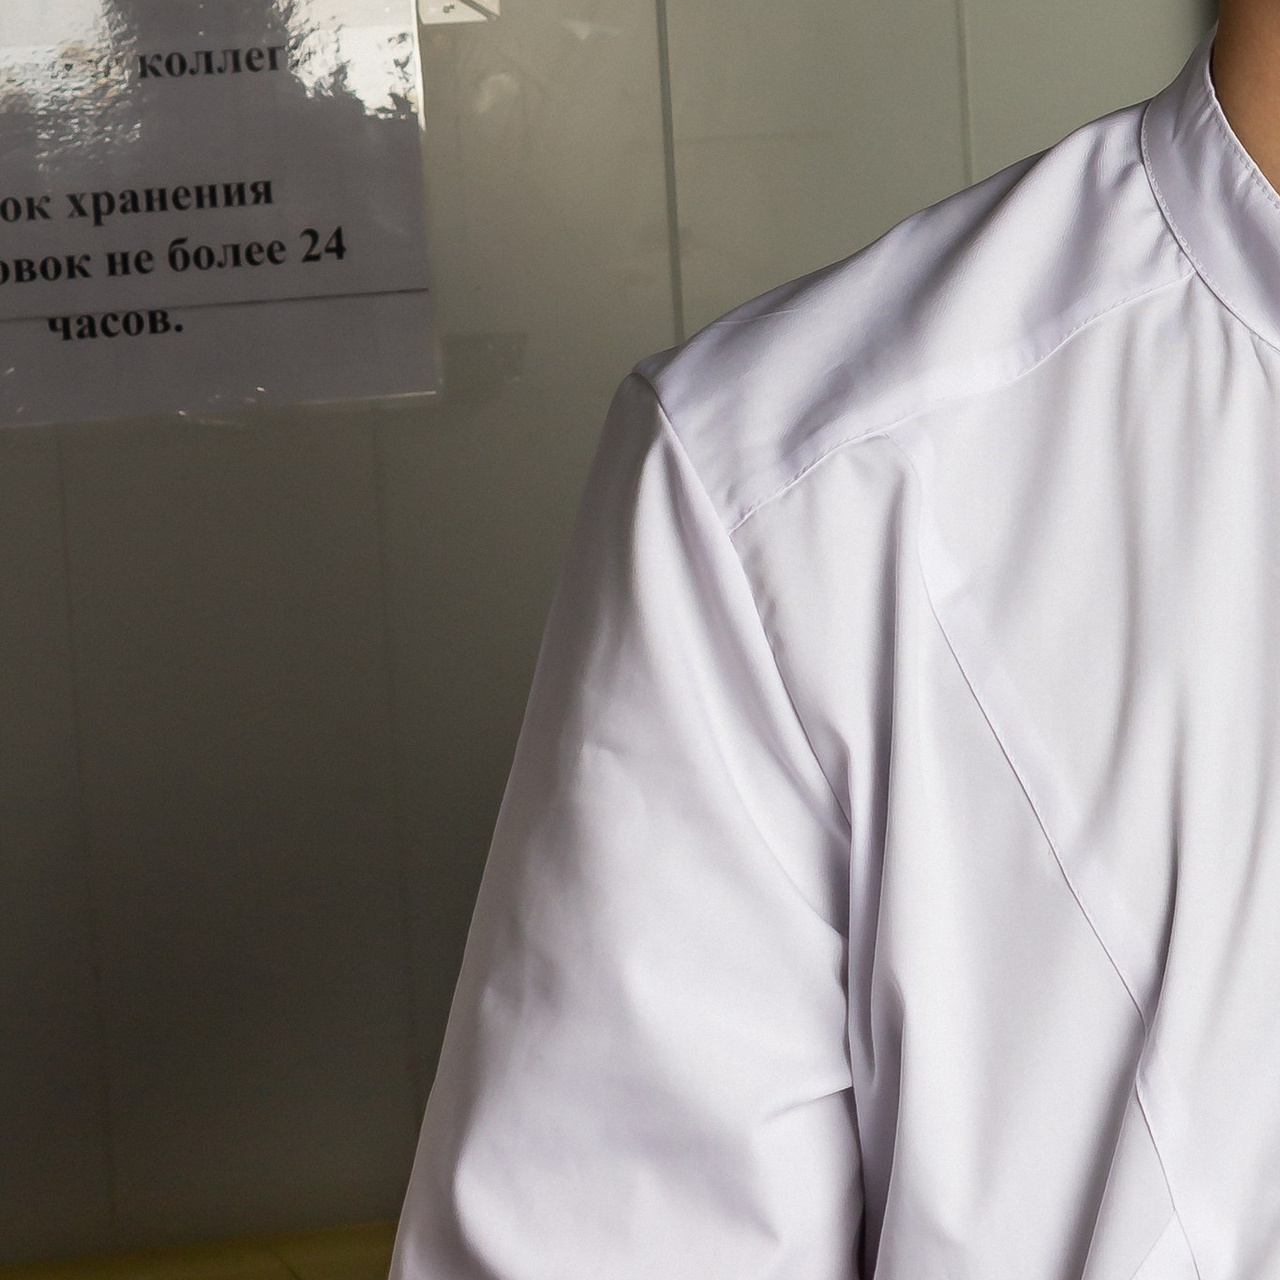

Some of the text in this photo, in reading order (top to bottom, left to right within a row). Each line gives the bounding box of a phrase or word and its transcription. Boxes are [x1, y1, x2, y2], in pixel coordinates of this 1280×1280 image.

[66, 180, 273, 227] хранения
[105, 248, 155, 276] не
[168, 237, 287, 272] более
[299, 226, 347, 263] 24
[46, 308, 184, 341] часов.
